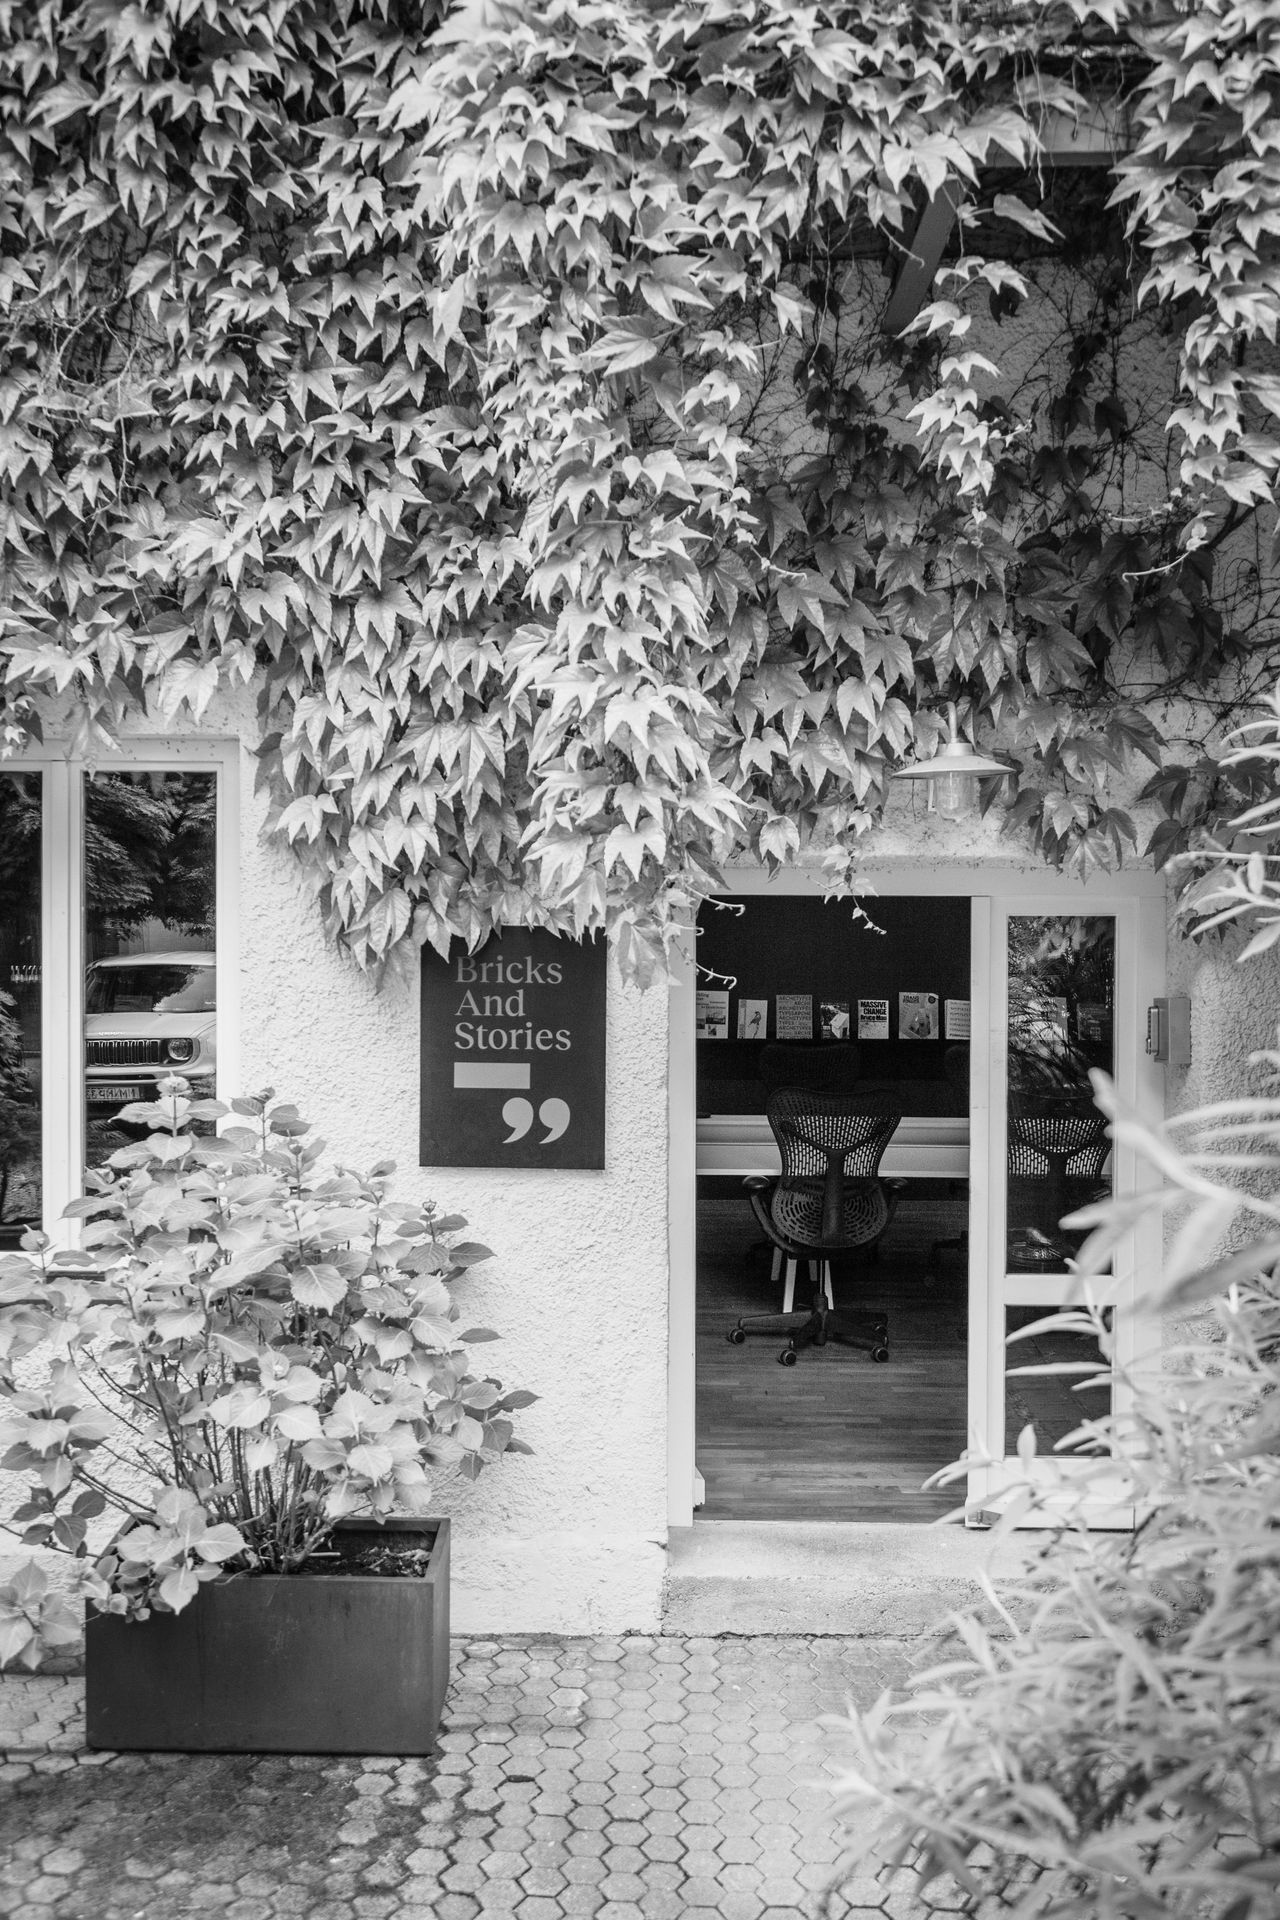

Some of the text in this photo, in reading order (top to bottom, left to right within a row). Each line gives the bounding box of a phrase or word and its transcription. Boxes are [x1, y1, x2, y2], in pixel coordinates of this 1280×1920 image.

[455, 955, 563, 984] Bricks
[454, 989, 526, 1016] And
[454, 1021, 571, 1051] Stories
